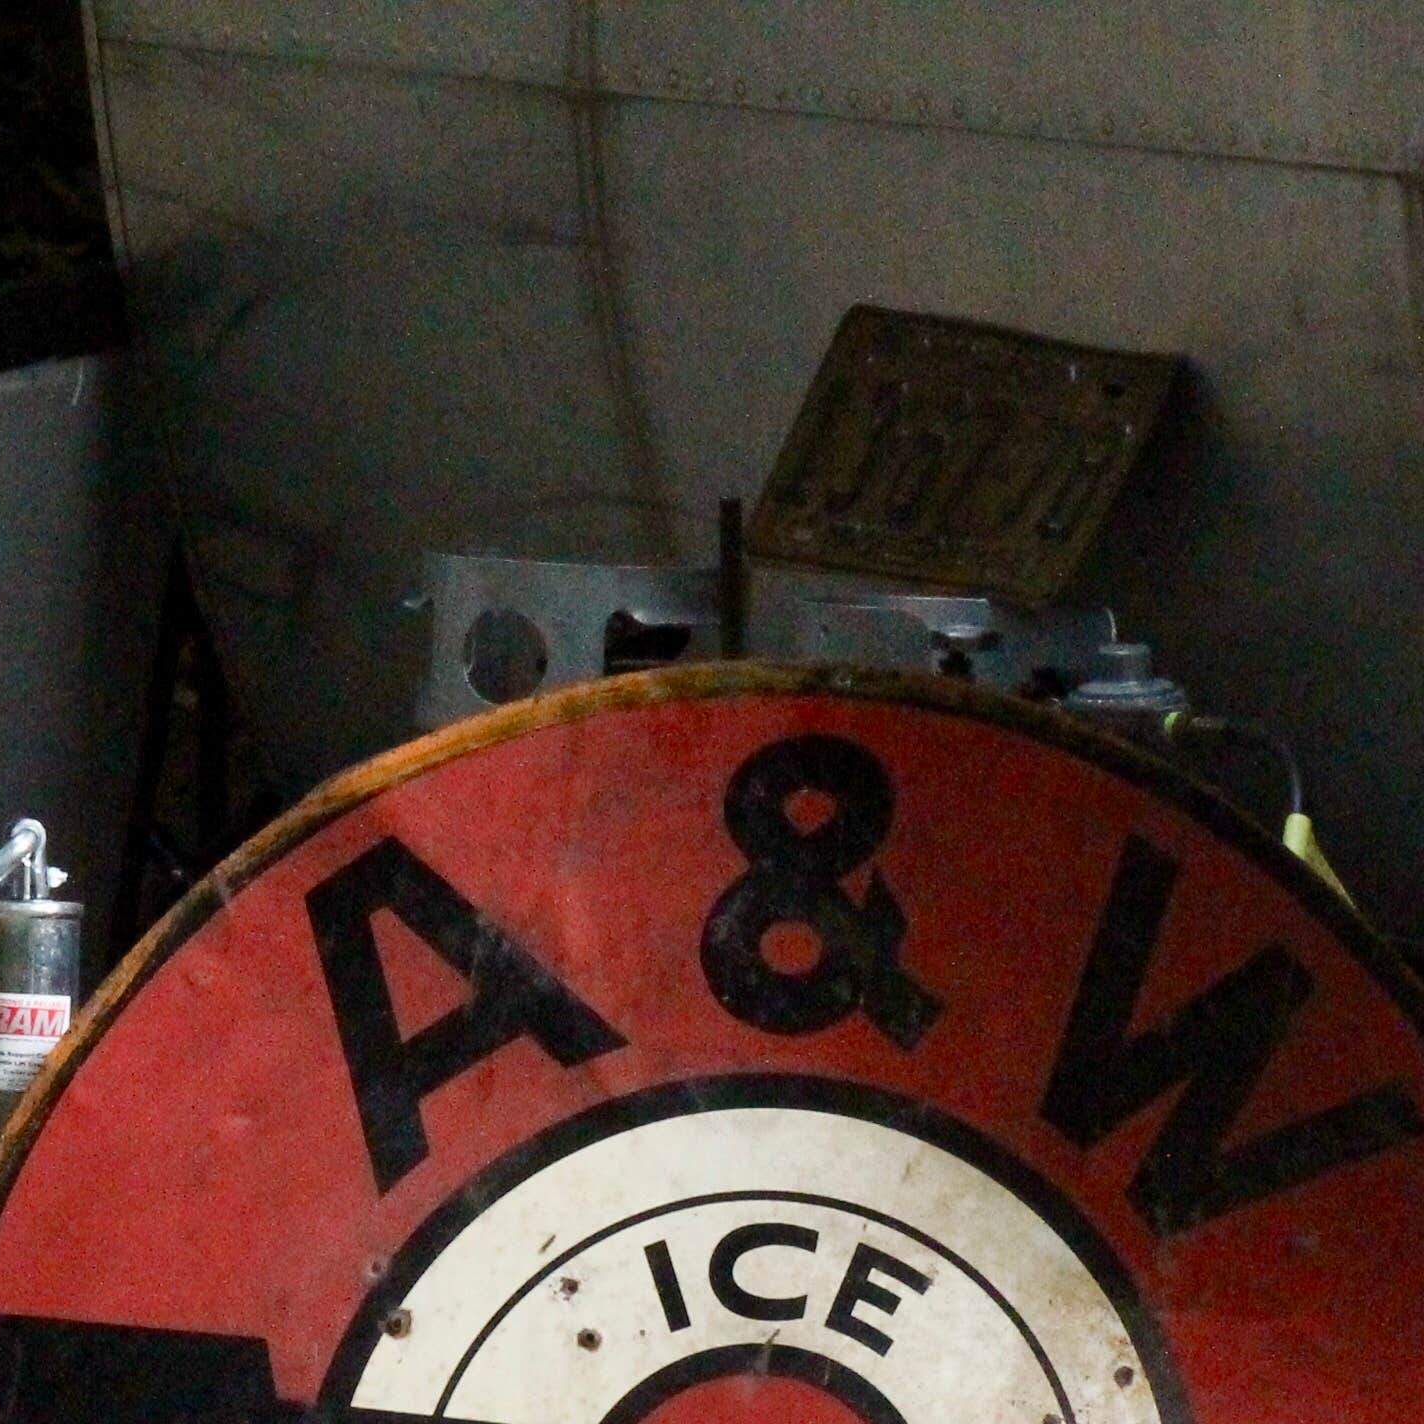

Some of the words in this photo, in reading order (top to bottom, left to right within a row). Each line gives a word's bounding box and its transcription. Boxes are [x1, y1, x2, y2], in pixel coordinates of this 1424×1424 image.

[306, 836, 629, 1194] A
[699, 733, 941, 1052] &
[643, 1222, 931, 1357] ICE
